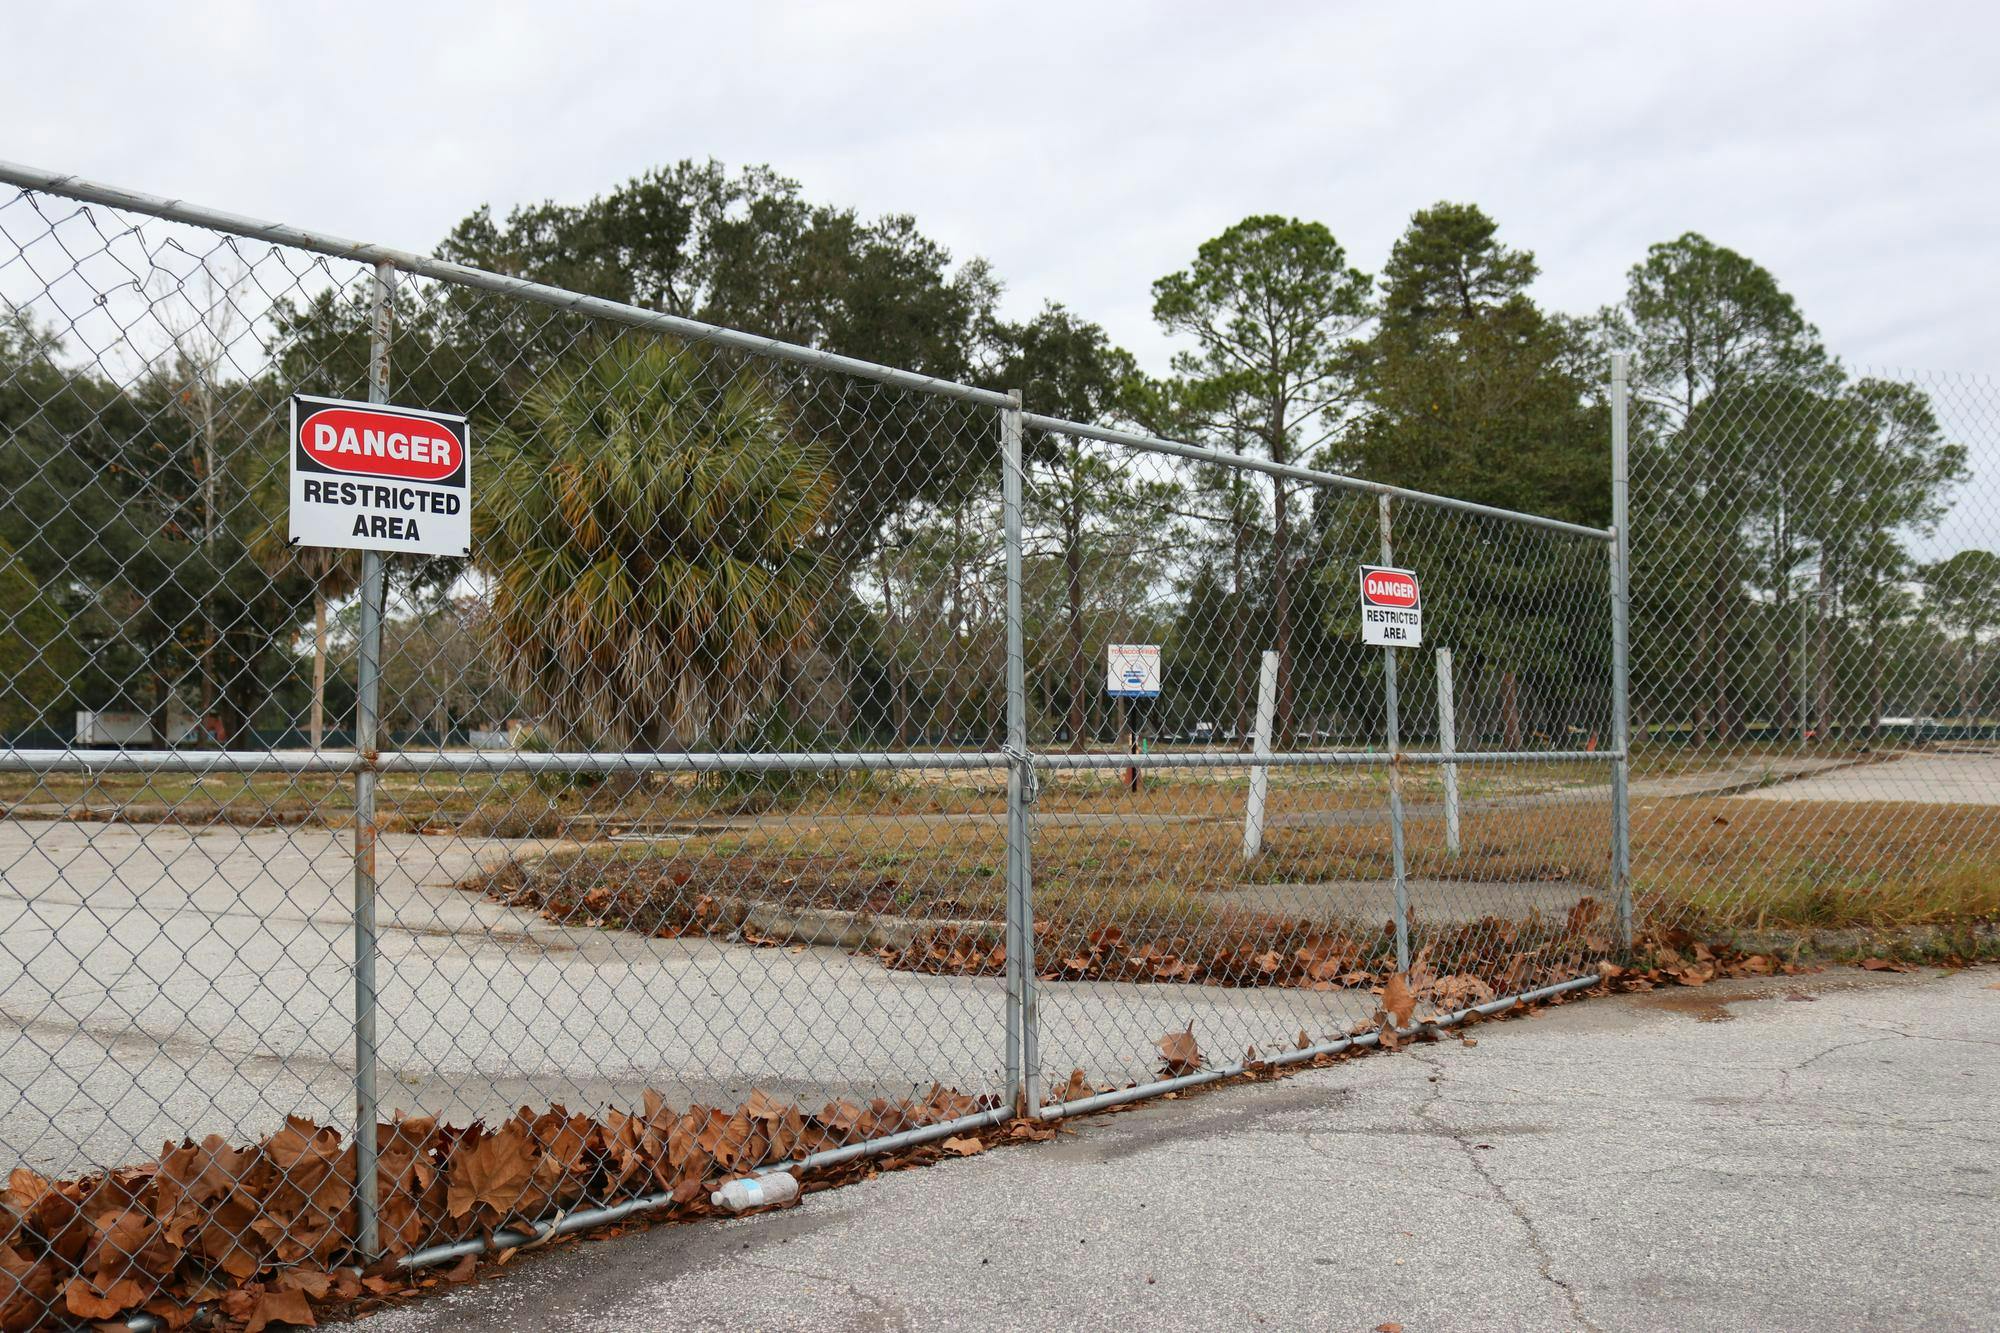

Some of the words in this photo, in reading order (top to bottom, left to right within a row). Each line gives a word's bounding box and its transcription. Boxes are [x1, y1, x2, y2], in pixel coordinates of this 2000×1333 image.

[314, 424, 451, 465] DANGER
[304, 480, 460, 515] RESTRICTED
[352, 514, 420, 541] AREA
[1368, 580, 1414, 598] DANGER
[1367, 611, 1418, 625] RESTRICTED
[1384, 627, 1407, 640] AREA
